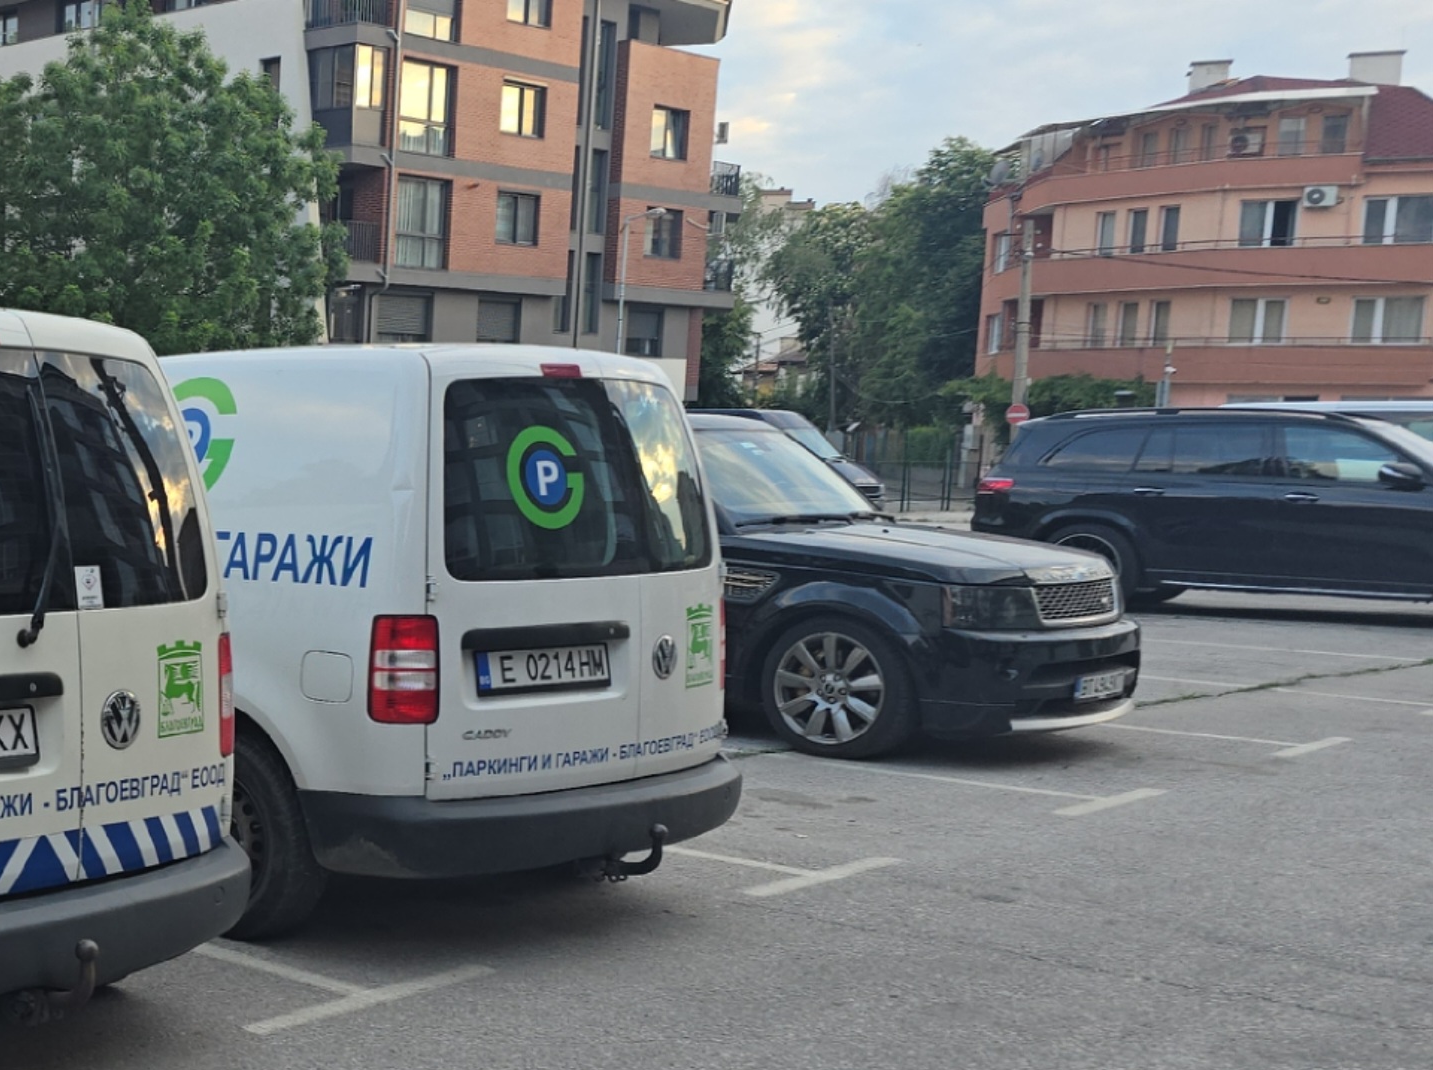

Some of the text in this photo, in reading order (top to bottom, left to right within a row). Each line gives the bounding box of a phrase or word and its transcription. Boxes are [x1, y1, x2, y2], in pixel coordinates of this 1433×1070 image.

[462, 729, 512, 740] CADDY
[542, 754, 551, 770] И
[555, 747, 610, 768] ГАРАЖИ
[191, 763, 225, 789] ЕООД
